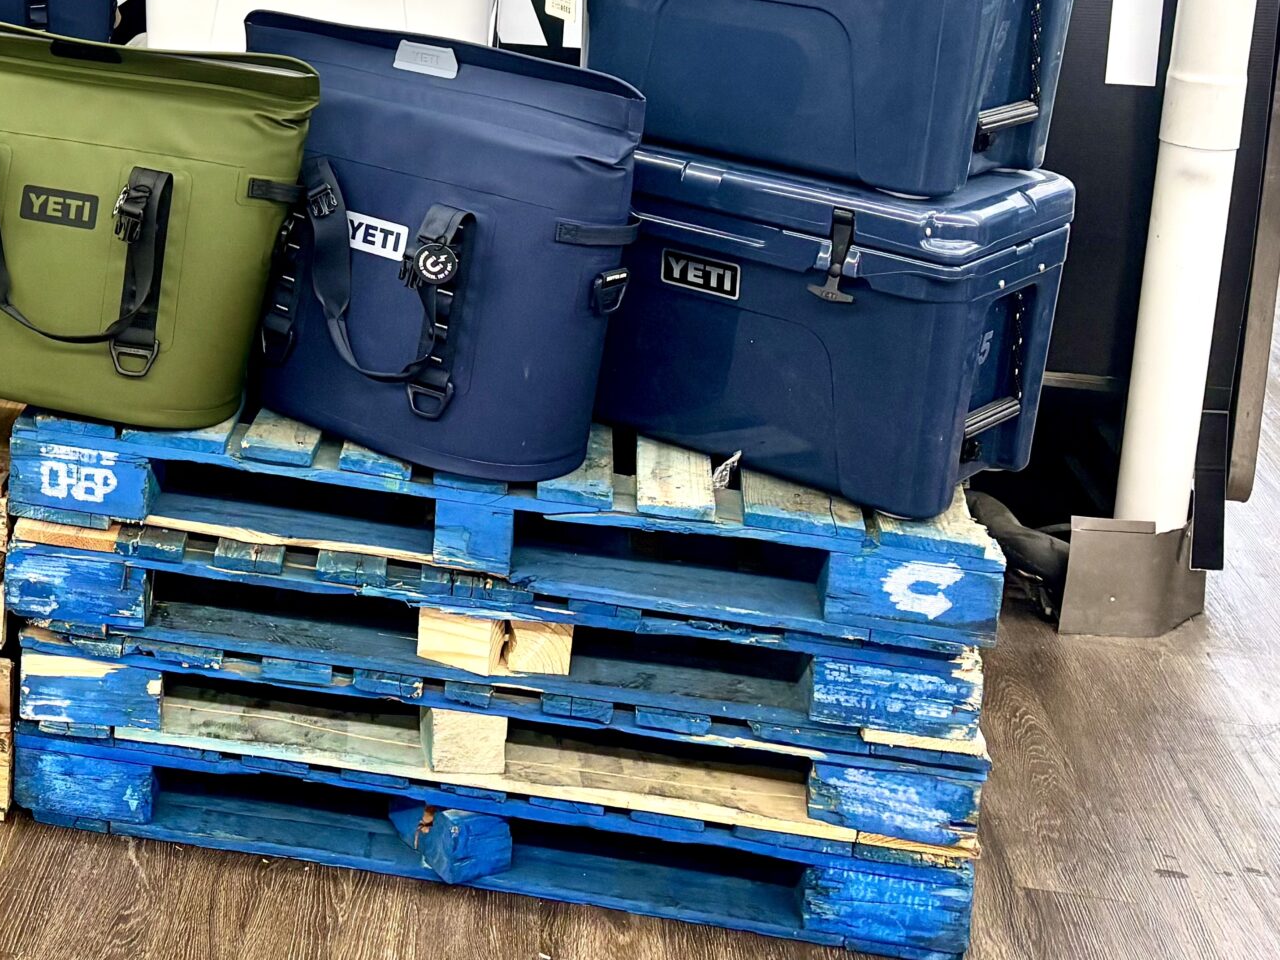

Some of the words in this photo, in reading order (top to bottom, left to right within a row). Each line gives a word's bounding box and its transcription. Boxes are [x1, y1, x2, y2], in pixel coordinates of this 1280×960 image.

[28, 192, 90, 222] YETI
[348, 219, 401, 252] YETI
[668, 256, 733, 291] YETI
